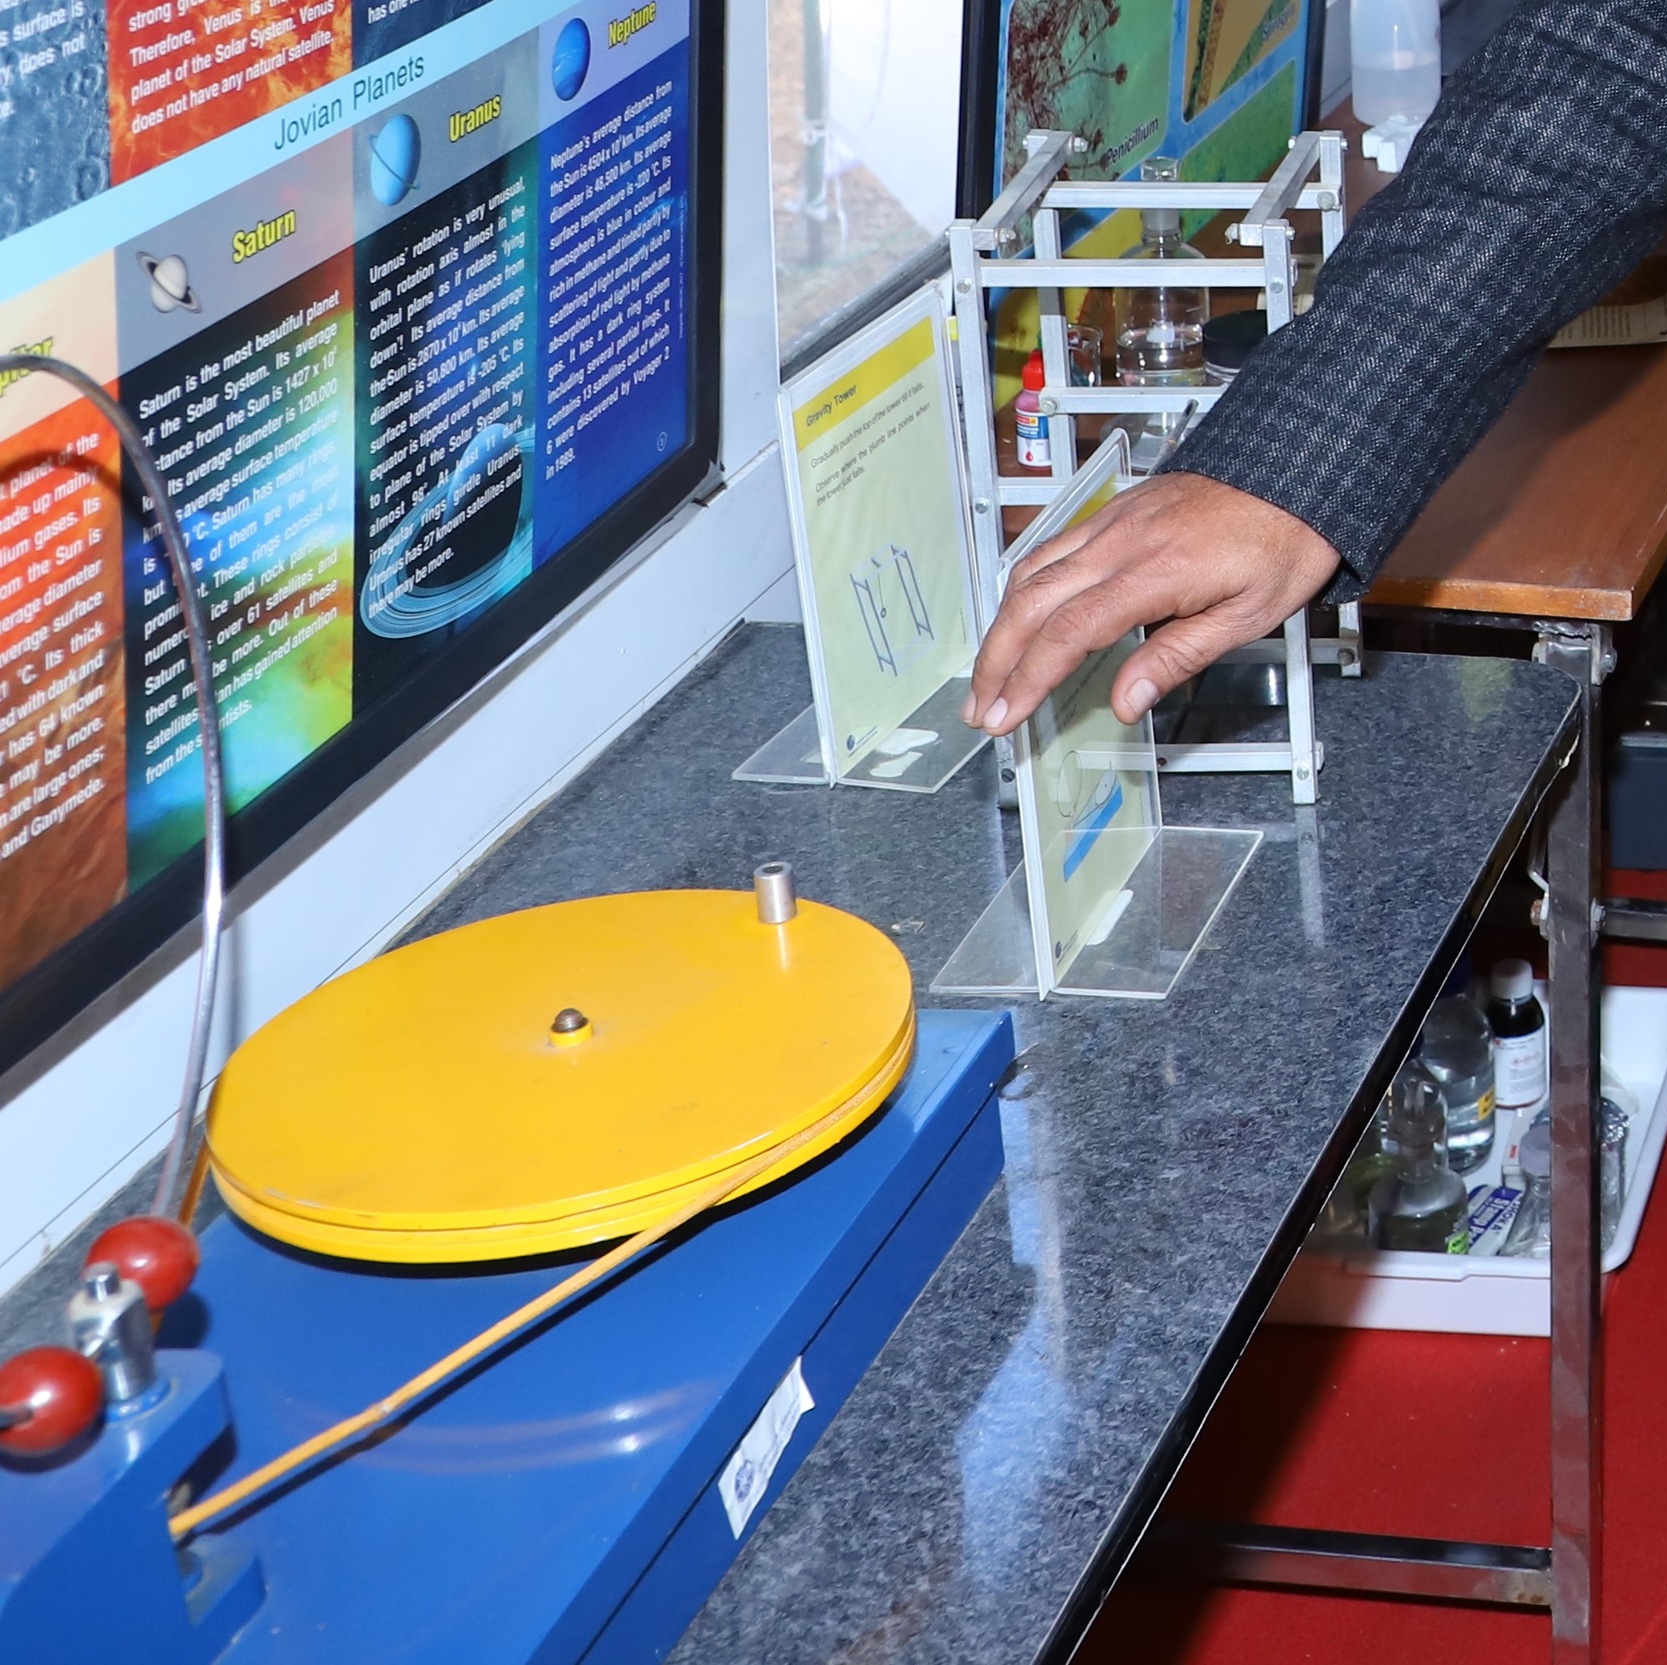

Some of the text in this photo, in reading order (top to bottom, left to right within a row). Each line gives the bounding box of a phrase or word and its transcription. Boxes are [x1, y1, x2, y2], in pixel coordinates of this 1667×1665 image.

[368, 4, 387, 23] has
[607, 1, 656, 48] Neptune
[274, 57, 423, 149] Jovian Planets
[448, 94, 501, 142] Uranus
[231, 209, 296, 263] Saturn
[412, 226, 449, 257] rotation
[453, 217, 462, 232] is
[465, 203, 485, 223] very
[369, 205, 525, 311] with rotation axis almost in the
[139, 290, 339, 418] Saturn is the most beautiful planet
[806, 385, 857, 426] Gravity Tower
